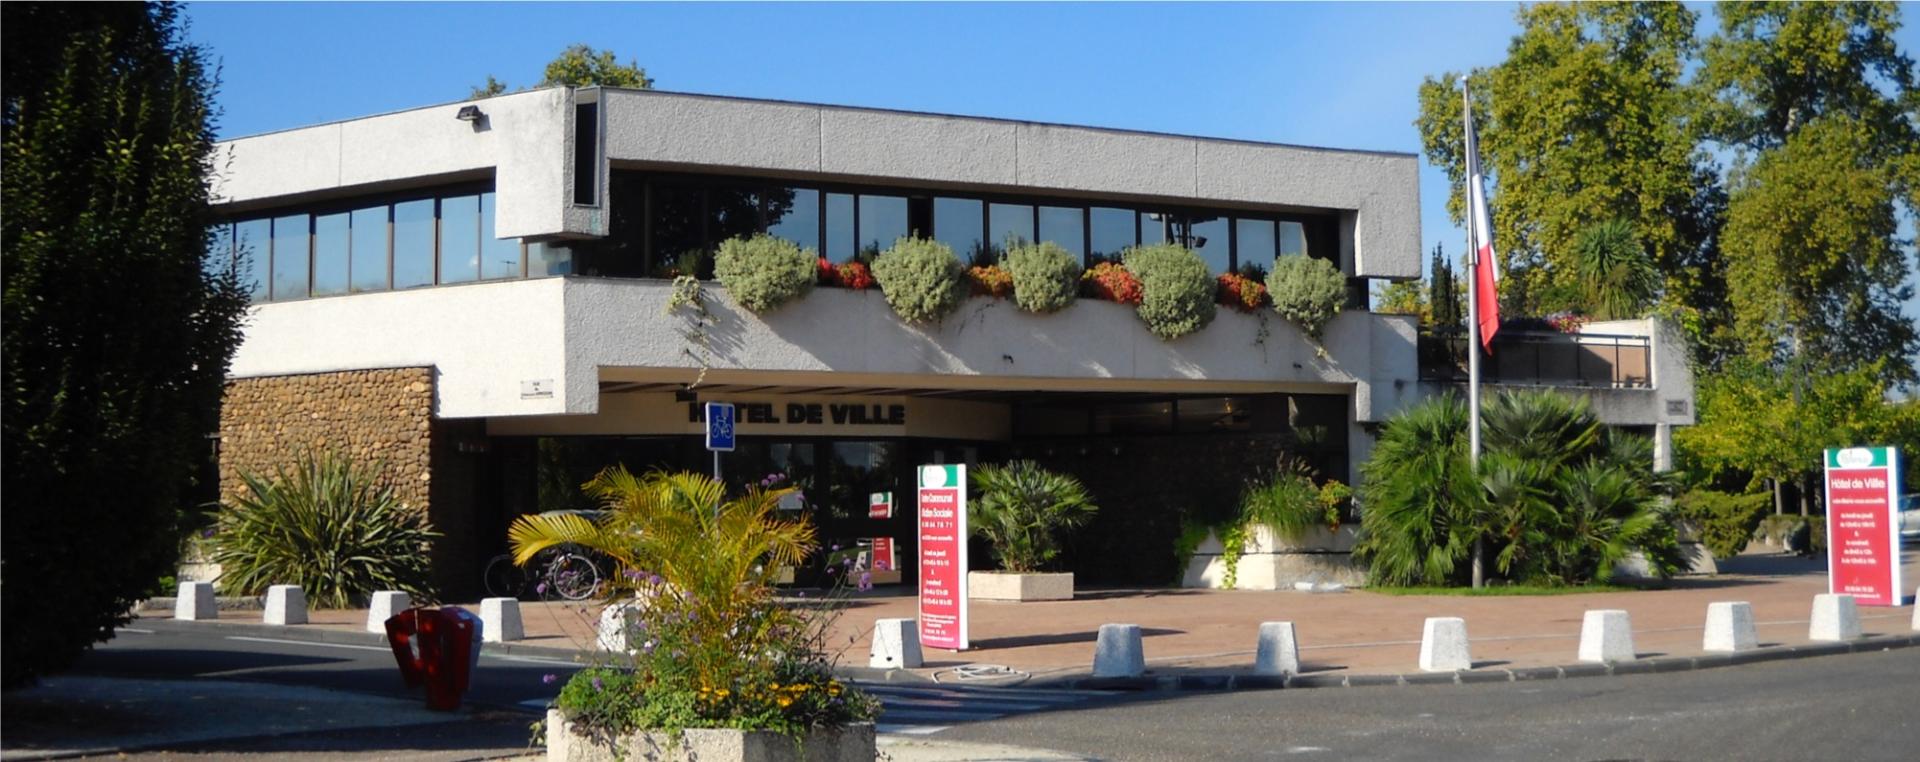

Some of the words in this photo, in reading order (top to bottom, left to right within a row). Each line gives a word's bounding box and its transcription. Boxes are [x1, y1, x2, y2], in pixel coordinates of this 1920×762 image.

[689, 401, 780, 424] HTEL
[787, 403, 823, 424] DE
[830, 403, 905, 425] VILLE
[1852, 478, 1863, 489] de
[1864, 477, 1886, 489] Ville
